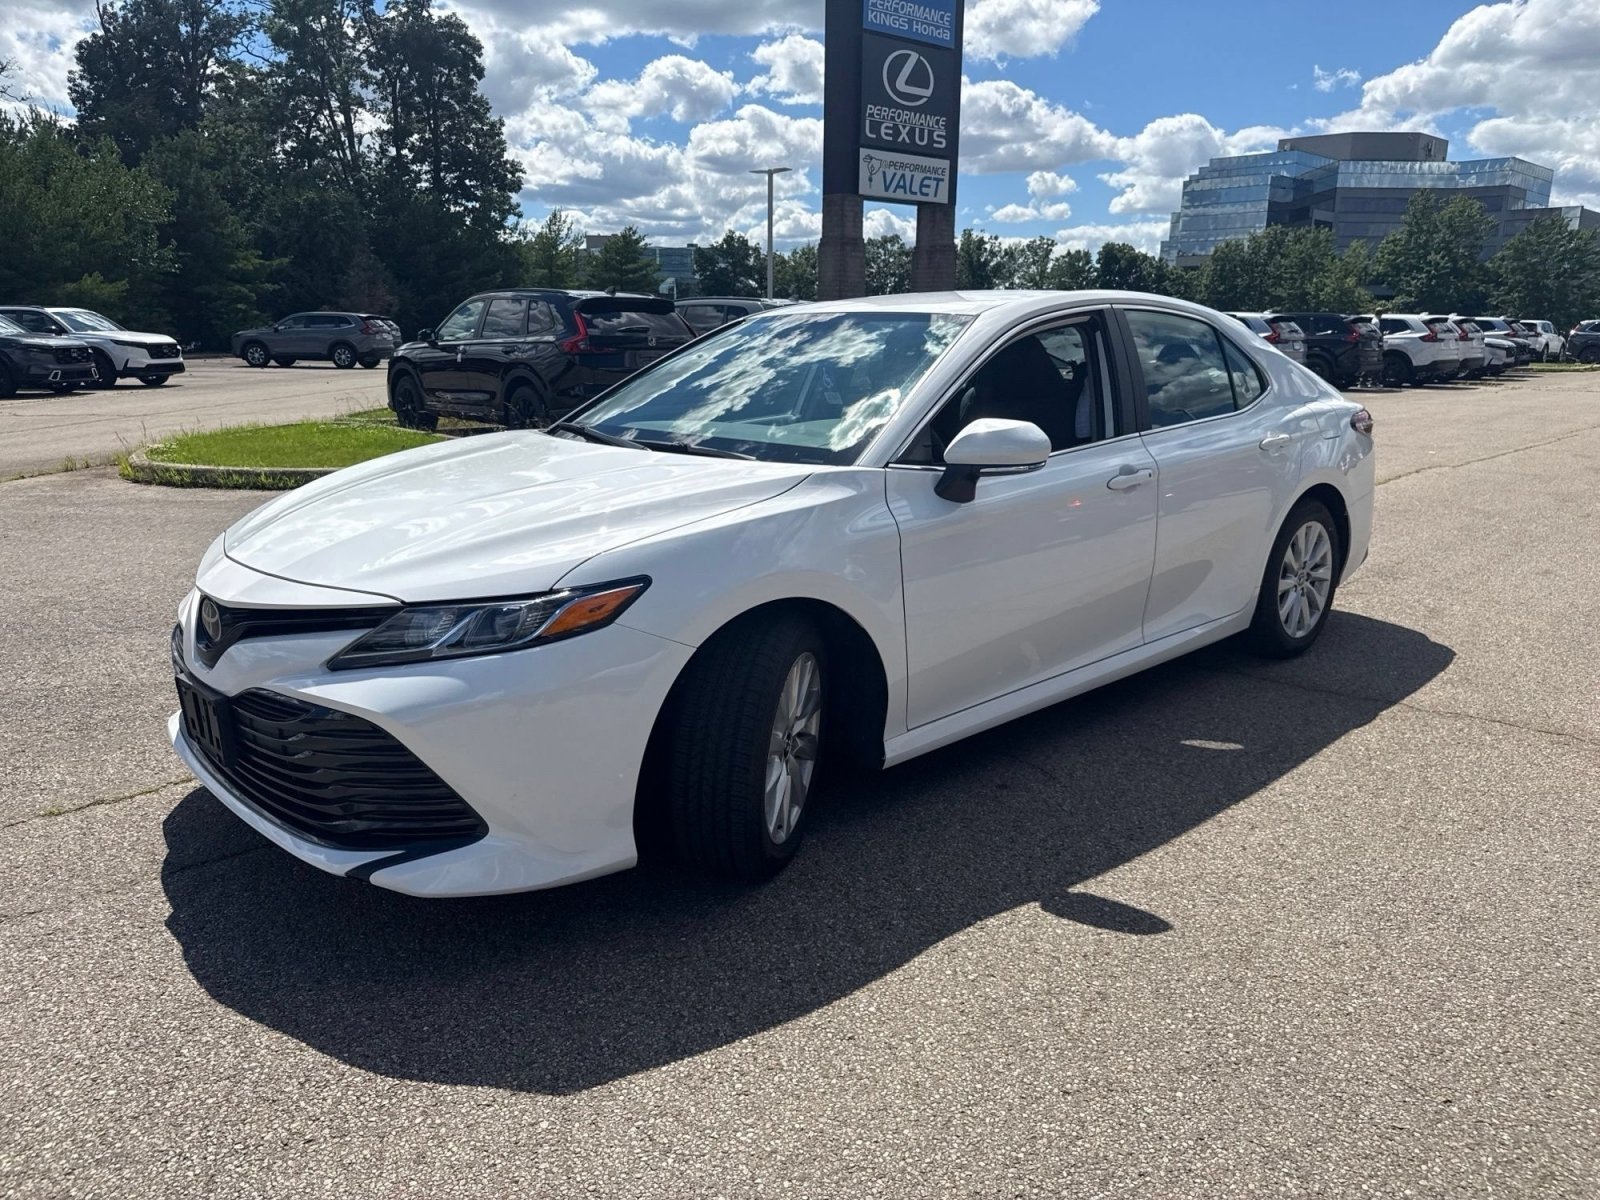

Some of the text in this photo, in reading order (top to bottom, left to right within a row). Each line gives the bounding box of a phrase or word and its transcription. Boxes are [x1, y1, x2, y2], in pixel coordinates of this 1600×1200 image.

[868, 10, 950, 40] KINGS Honda
[869, 0, 951, 25] PERFORMANCE
[866, 104, 946, 129] PERFORMANCE
[865, 119, 946, 148] LEXUS
[888, 160, 946, 176] PERFORMANCE
[882, 171, 944, 197] VALET
